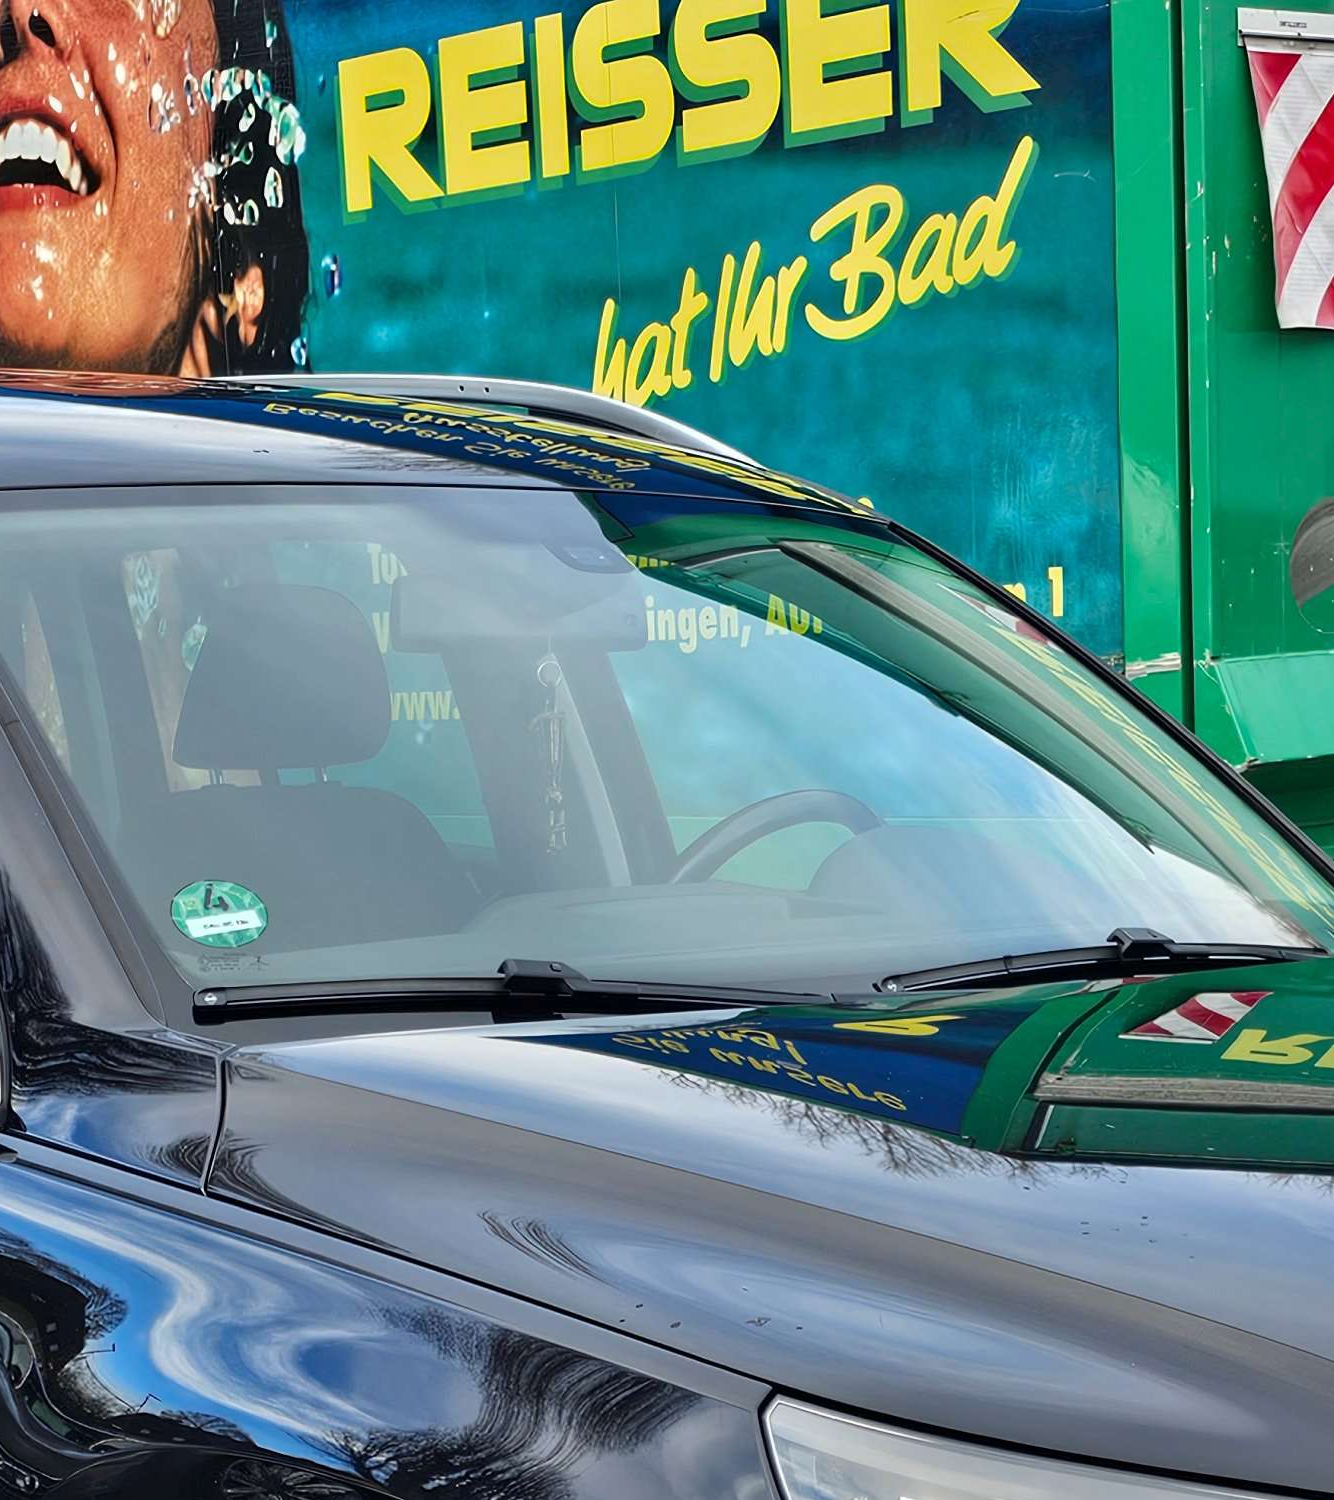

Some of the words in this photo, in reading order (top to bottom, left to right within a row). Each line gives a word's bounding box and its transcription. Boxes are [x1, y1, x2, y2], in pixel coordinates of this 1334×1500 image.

[338, 0, 1042, 213] REISSER
[593, 298, 708, 408] hat
[709, 241, 807, 382] Ihr
[805, 136, 1034, 340] Bad
[645, 595, 751, 654] ingen,
